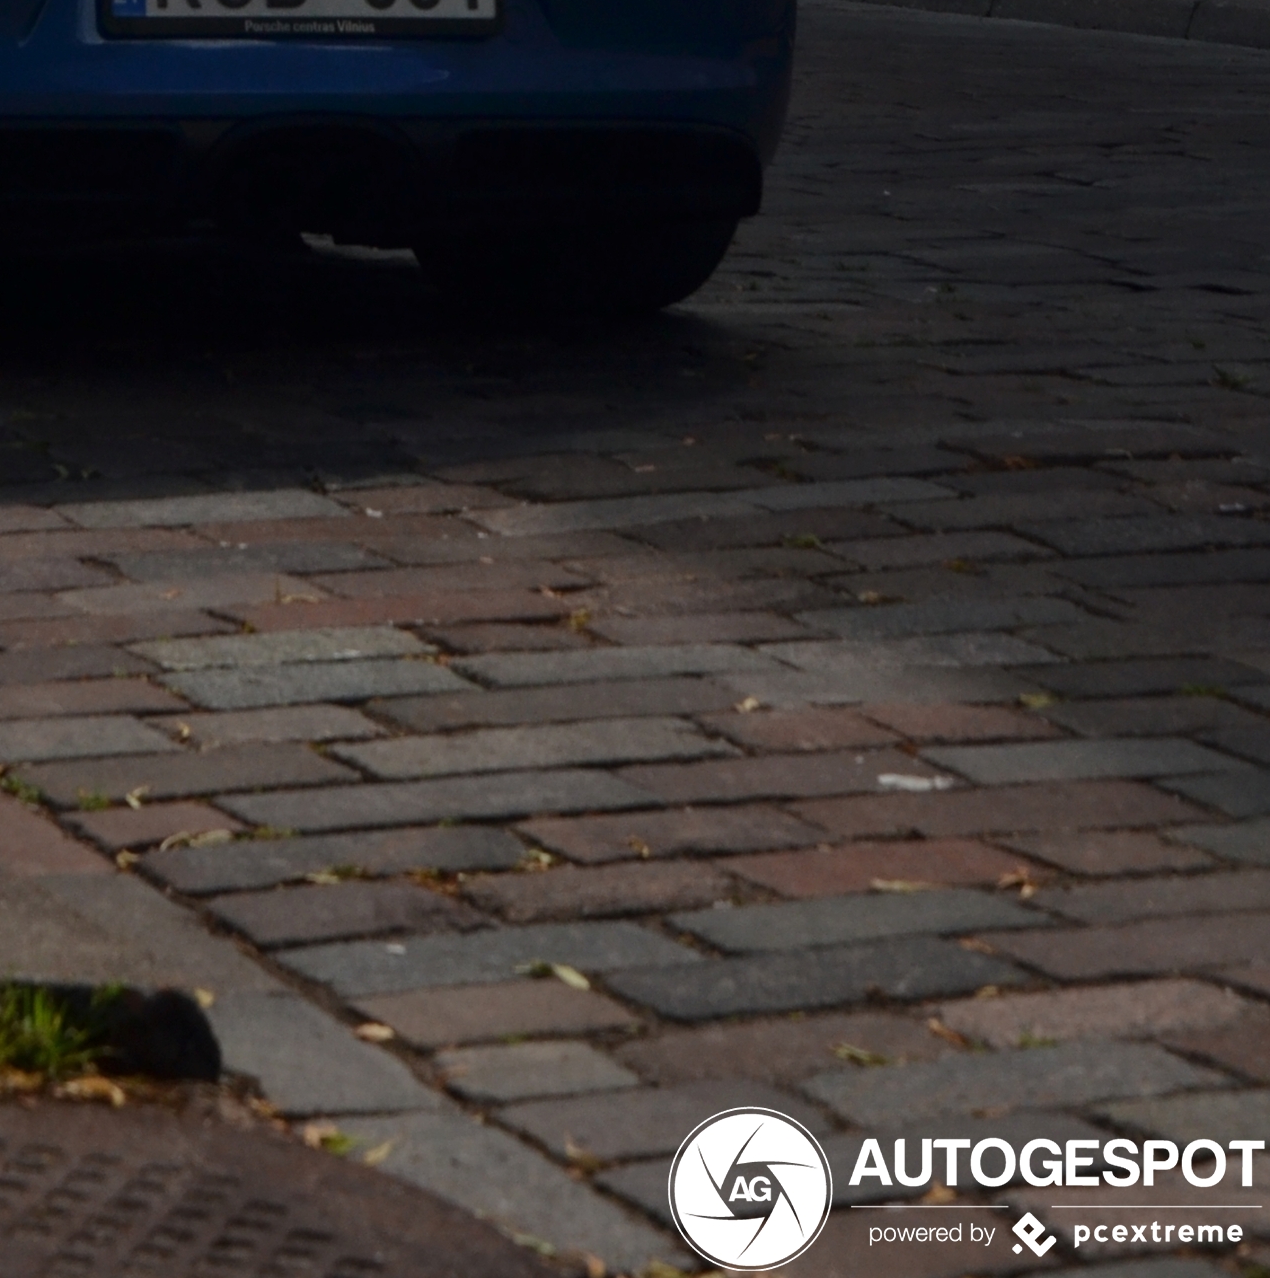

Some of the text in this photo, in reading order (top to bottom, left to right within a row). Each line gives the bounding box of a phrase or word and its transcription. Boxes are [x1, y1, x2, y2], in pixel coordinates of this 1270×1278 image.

[244, 19, 376, 33] Porsche centras Vilnius
